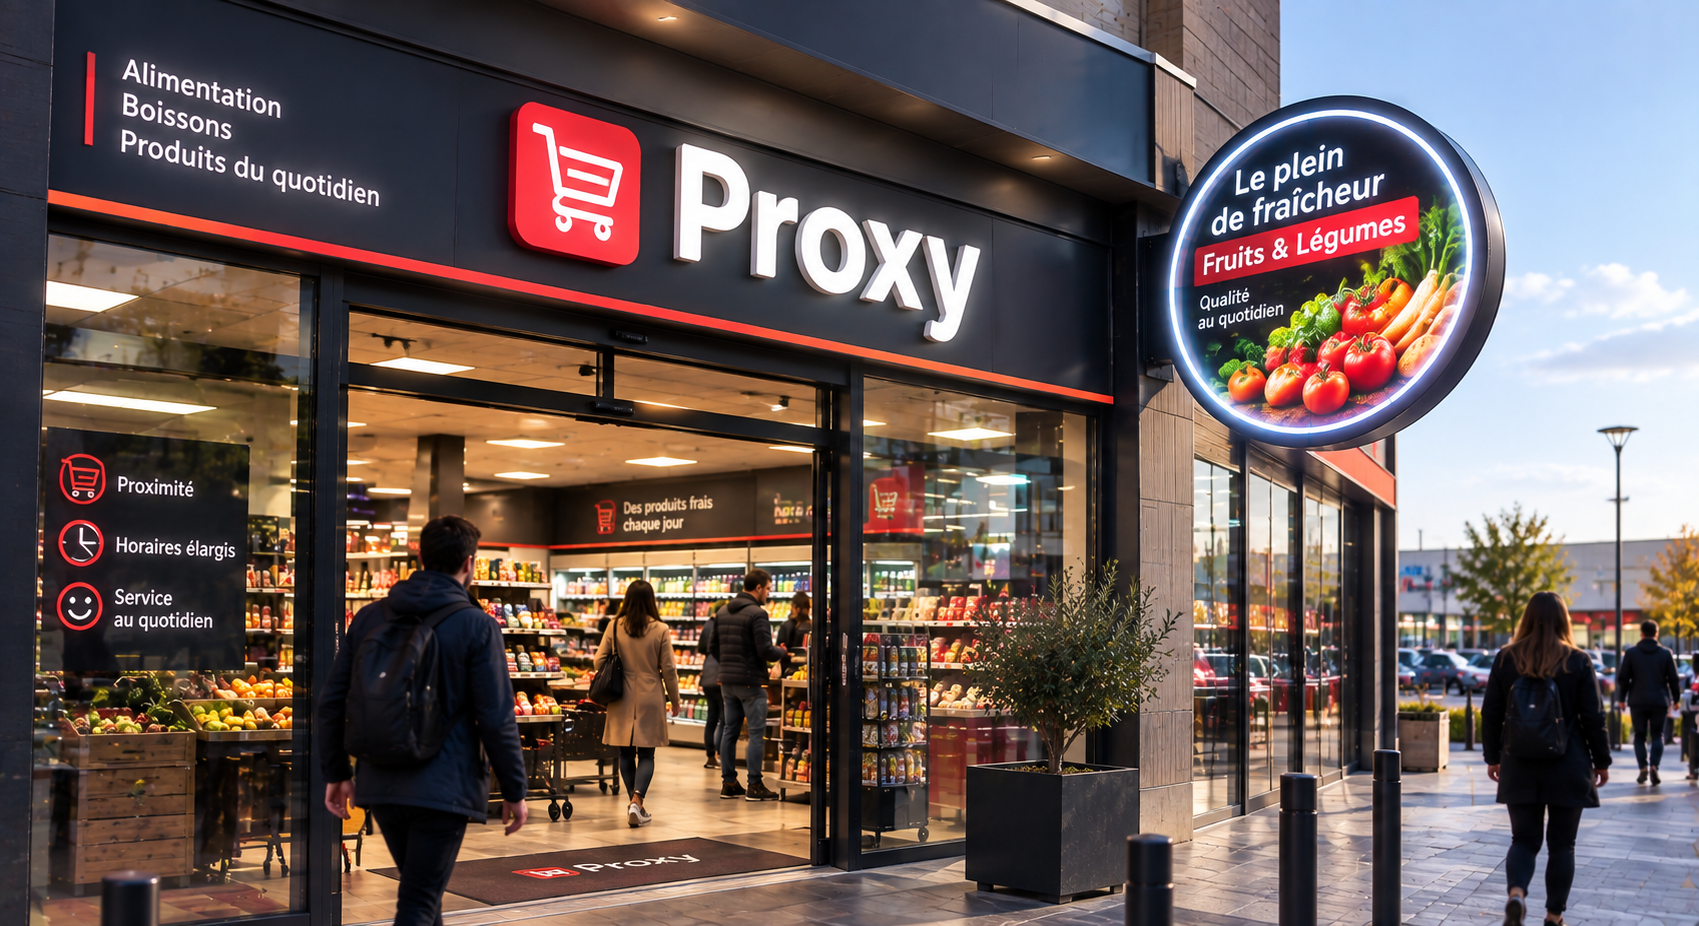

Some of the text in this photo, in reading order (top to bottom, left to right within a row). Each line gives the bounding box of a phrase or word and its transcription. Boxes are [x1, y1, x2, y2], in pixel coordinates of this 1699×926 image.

[122, 58, 282, 119] Alimentation
[122, 92, 232, 140] Boissons
[120, 129, 380, 207] Produits du quotidien
[1234, 144, 1344, 195] Le plein
[1211, 173, 1385, 236] de fraîcheur
[673, 143, 981, 342] Proxy
[1203, 214, 1406, 275] Fruits & Légumes
[1200, 288, 1250, 310] Qualité
[1198, 302, 1284, 329] au quotidien
[117, 476, 194, 497] Proximité
[623, 495, 713, 516] Des produits frais
[623, 516, 684, 534] chaque jour
[116, 536, 235, 561] Horaires élargis
[114, 588, 173, 606] Service
[114, 611, 213, 632] au quotidien
[573, 854, 700, 872] Proxy
